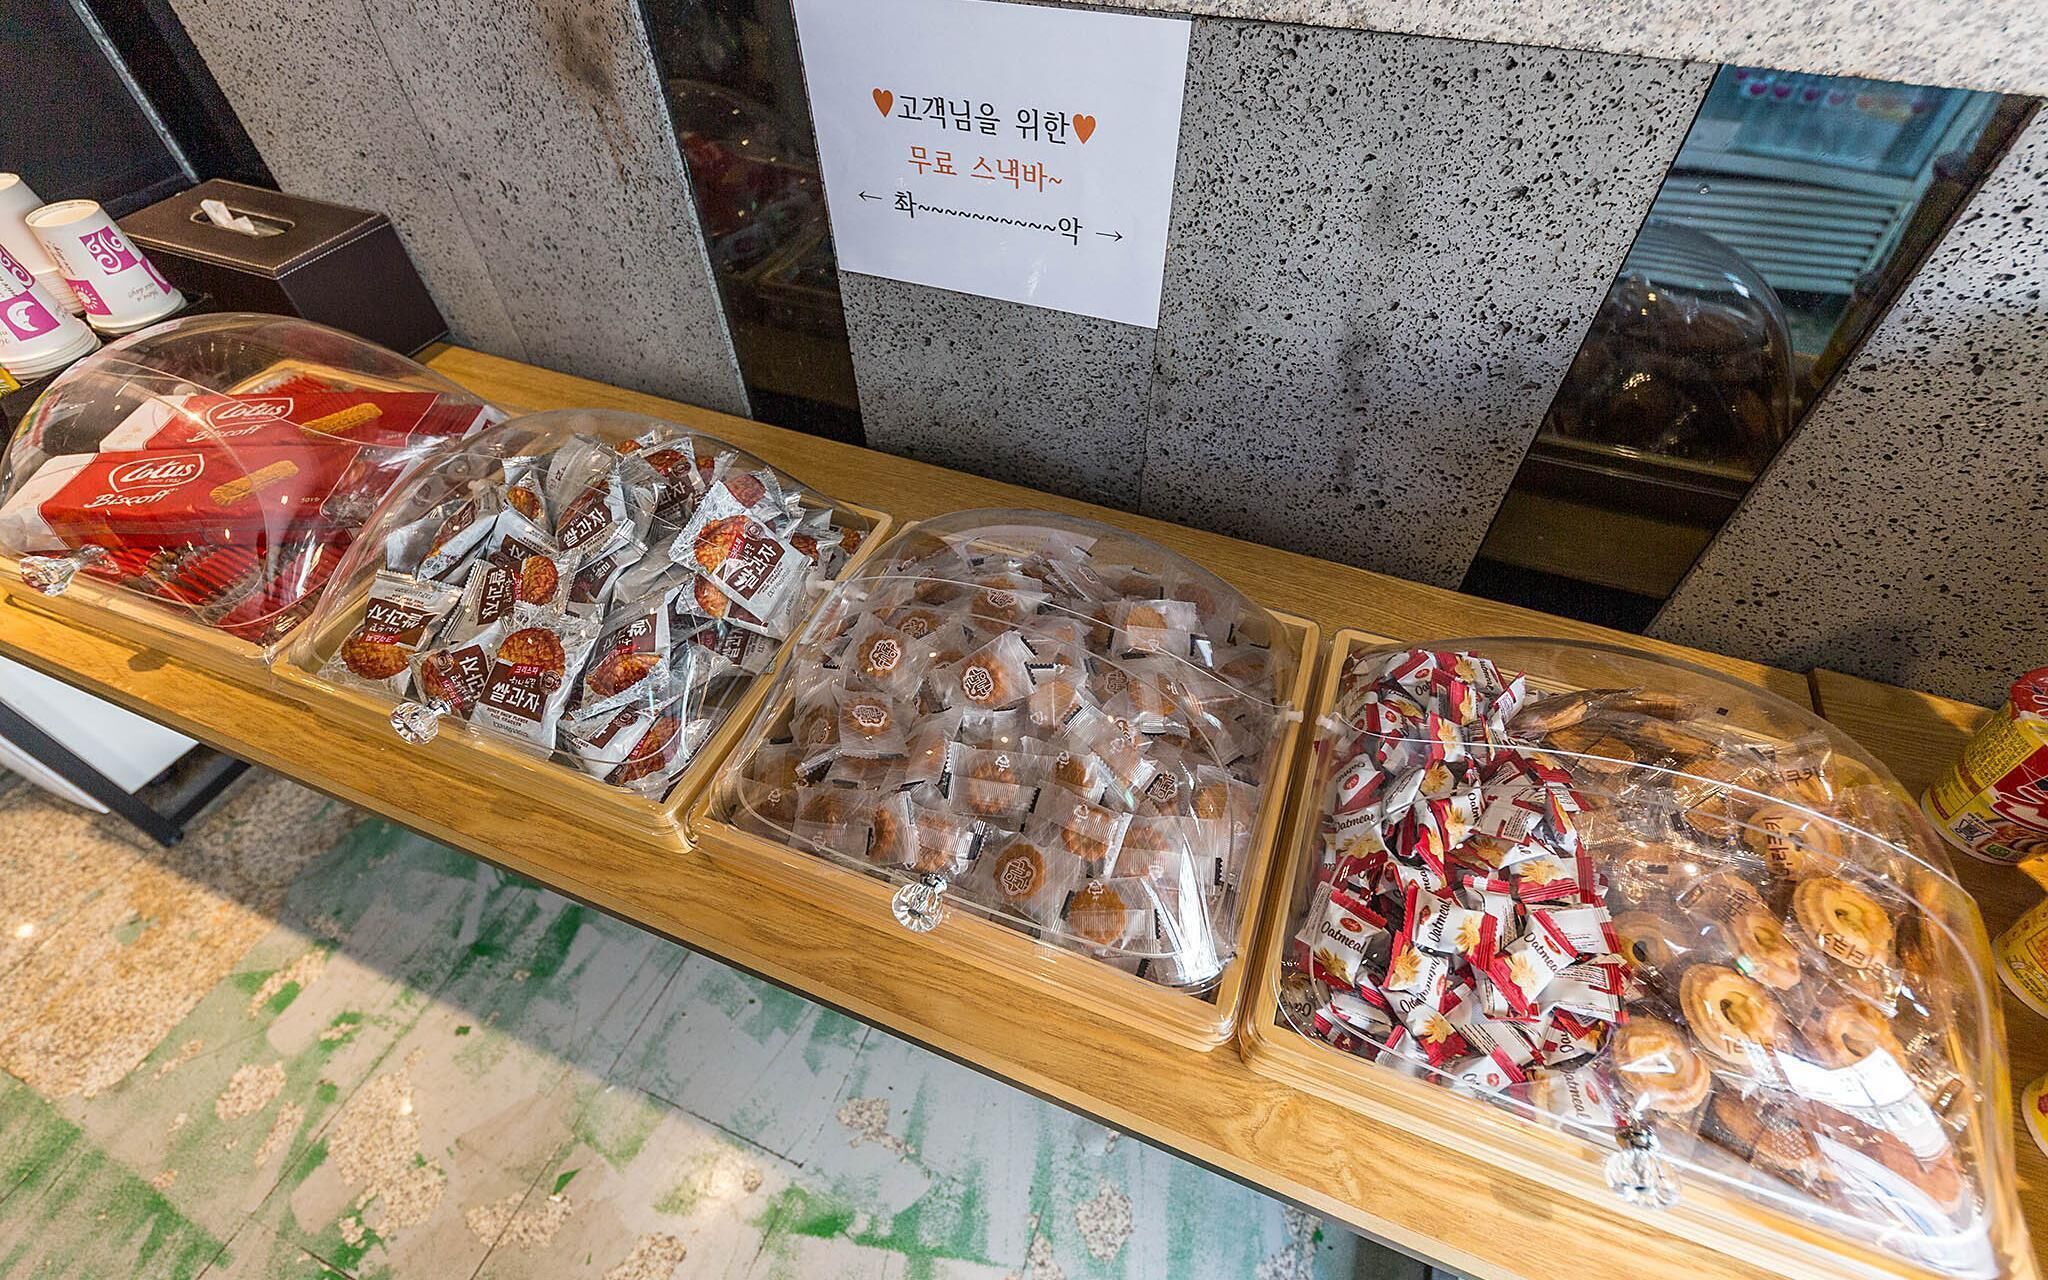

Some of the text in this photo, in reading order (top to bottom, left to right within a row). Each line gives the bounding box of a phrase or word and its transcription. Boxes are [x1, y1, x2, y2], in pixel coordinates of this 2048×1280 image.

[897, 94, 1070, 145] 고객님을 위한
[908, 145, 1063, 192] 무료 스낵바~
[216, 402, 286, 420] Lotus
[120, 460, 196, 482] Lotus
[84, 488, 172, 509] Biscoff
[563, 507, 607, 548] 쌀과자
[734, 543, 777, 590] 쌀과자
[482, 568, 507, 619] 쌀과자
[367, 604, 423, 629] 쌀과자
[489, 682, 540, 713] 쌀과자
[1320, 920, 1367, 954] Oatmeal
[1428, 898, 1452, 944] Oatmeal
